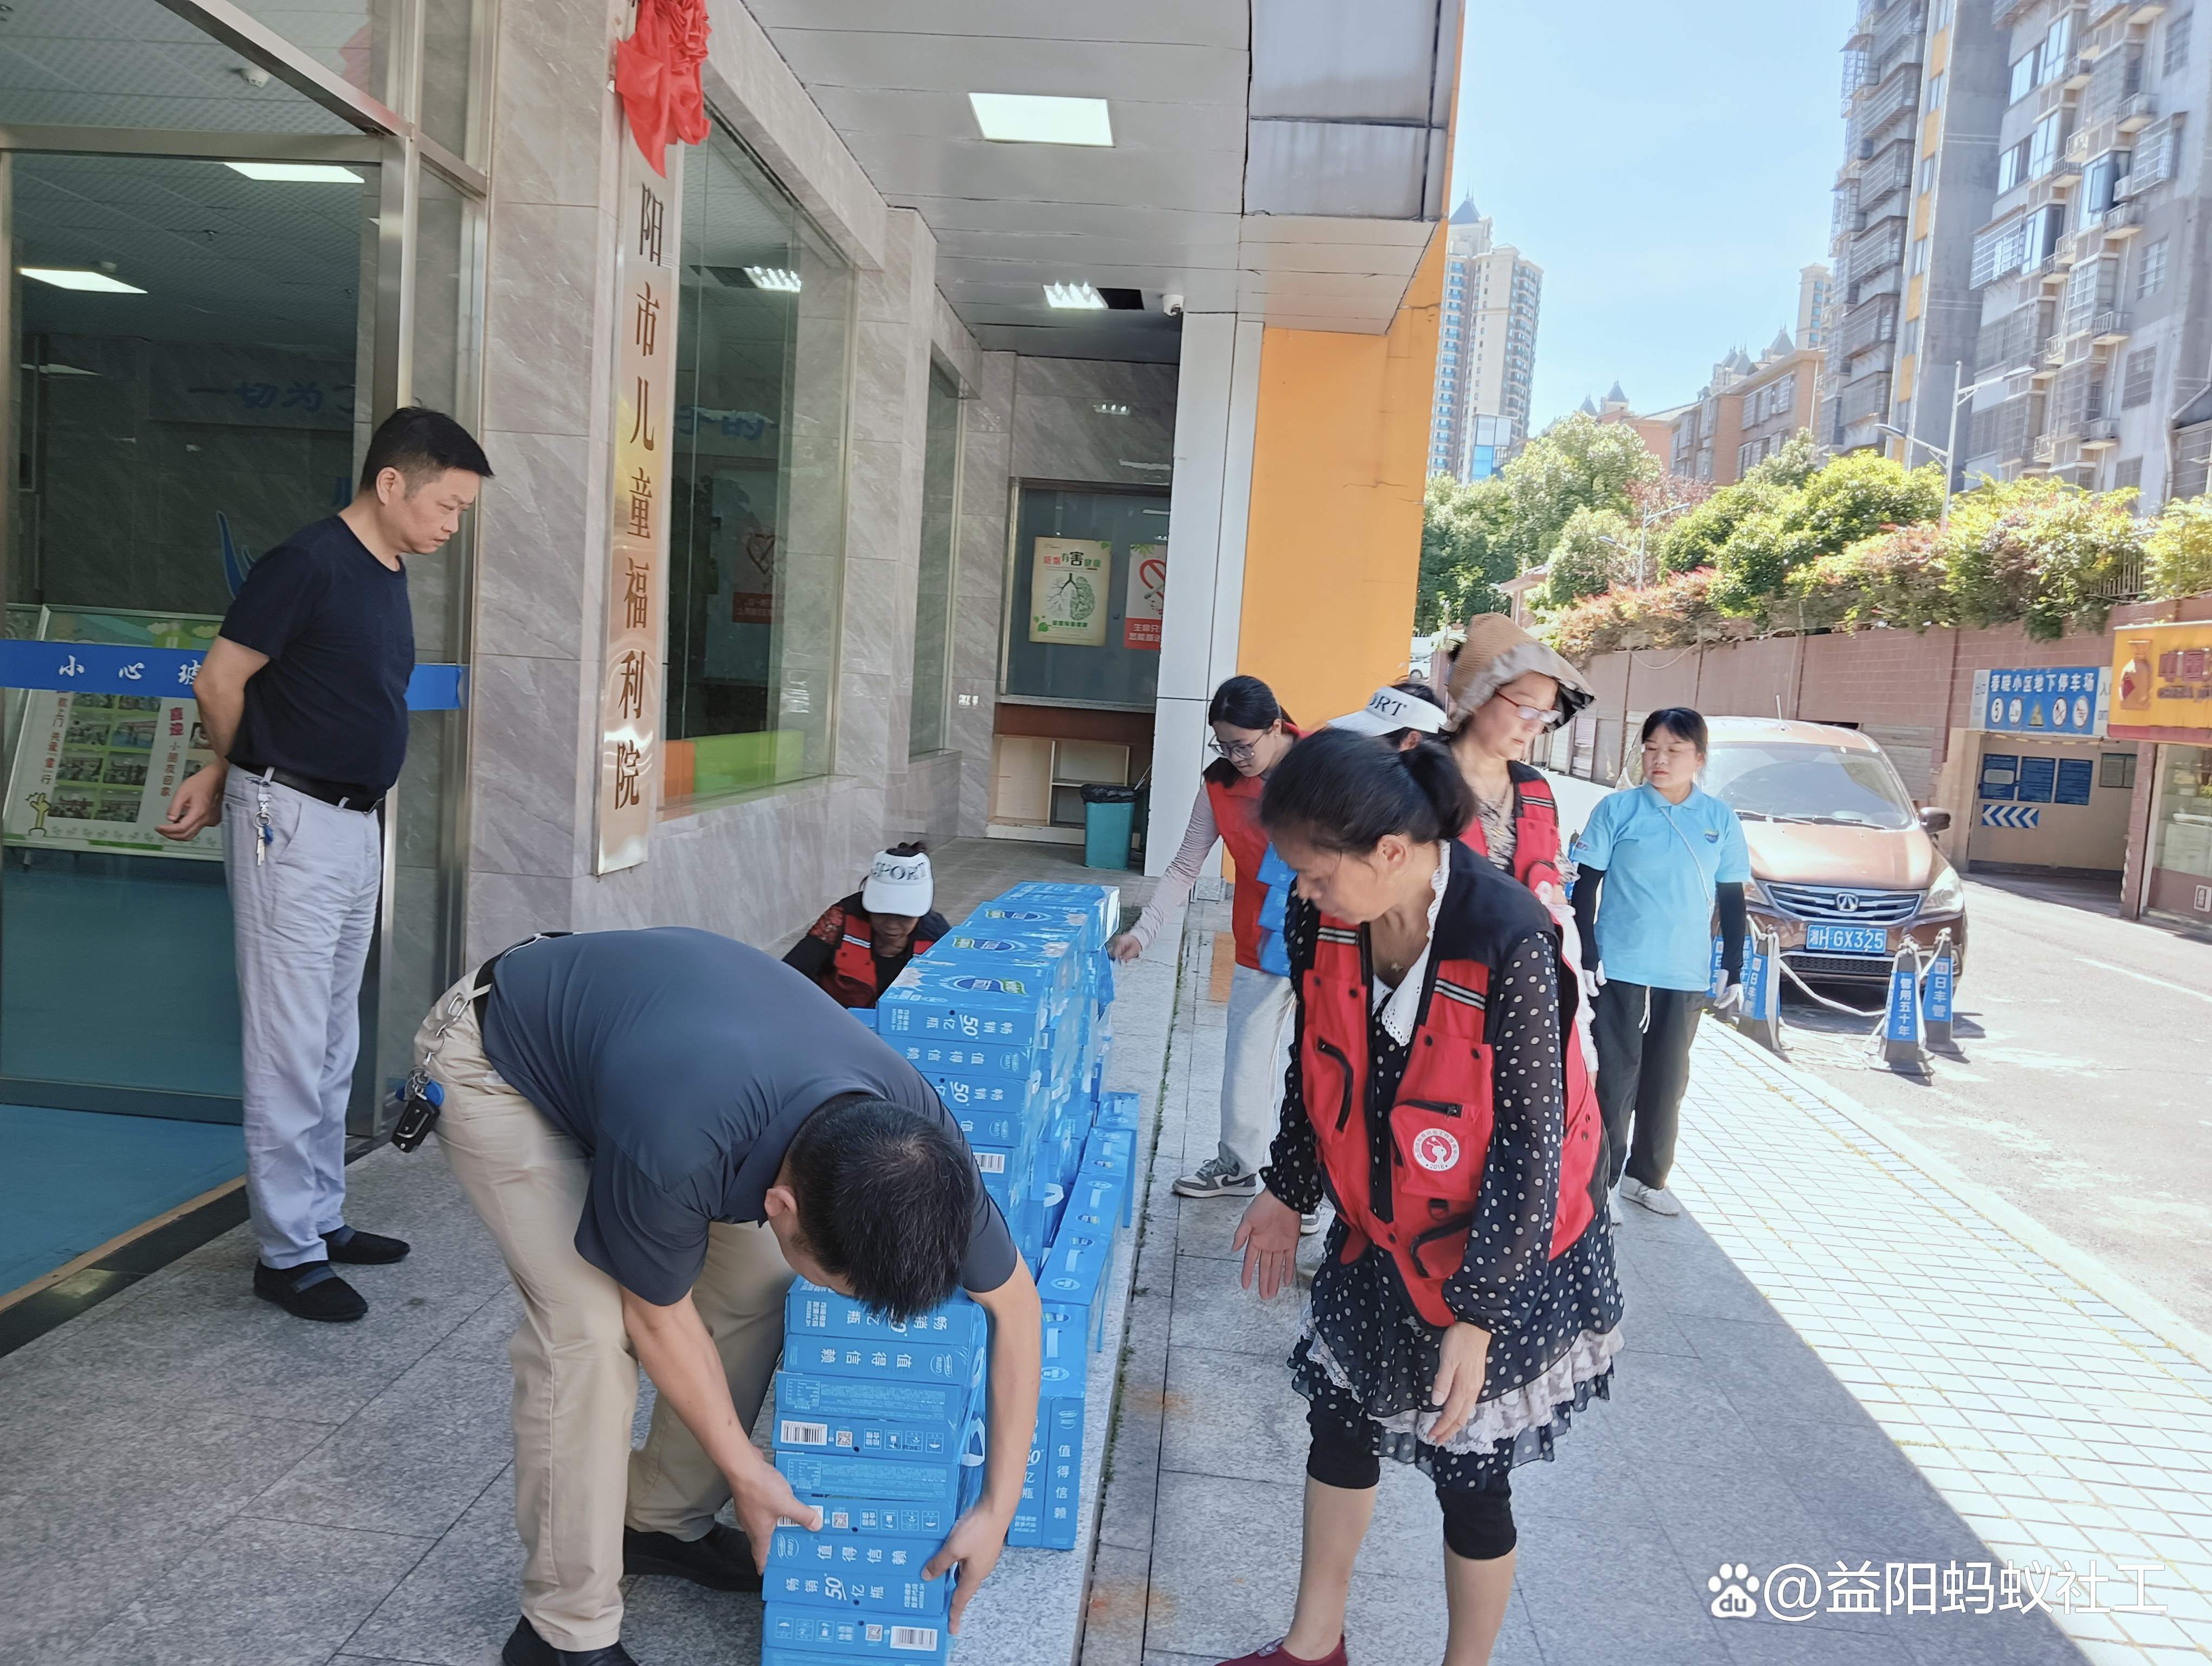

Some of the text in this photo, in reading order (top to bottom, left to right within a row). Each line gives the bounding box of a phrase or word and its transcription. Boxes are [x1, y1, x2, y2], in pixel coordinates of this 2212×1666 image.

[614, 181, 664, 810] 阳市儿童福利院
[1898, 978, 1913, 1036] 管用五十年
[846, 1309, 948, 1334] 畅销0亿瓶
[820, 1348, 912, 1368] 值得信赖
[1053, 1444, 1071, 1520] 值得信赖
[816, 1544, 907, 1566] 值得信赖
